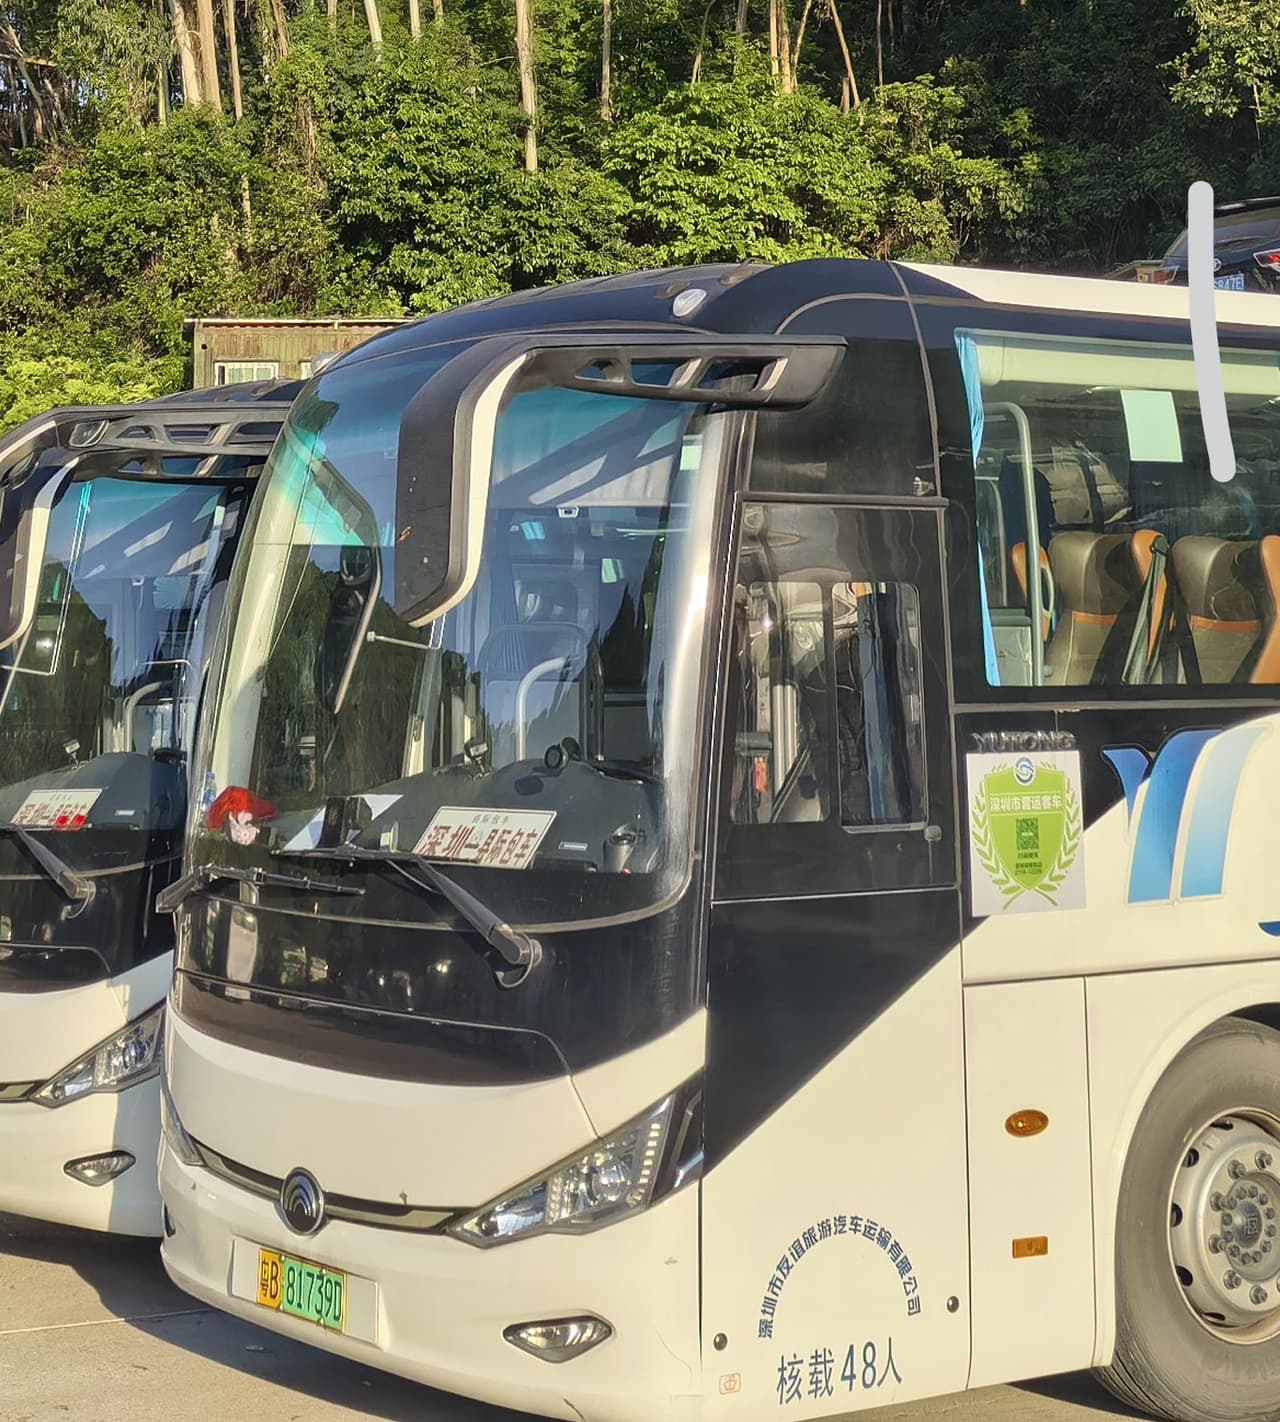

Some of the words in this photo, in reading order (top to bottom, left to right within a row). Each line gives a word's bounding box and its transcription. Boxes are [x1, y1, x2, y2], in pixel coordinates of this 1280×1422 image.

[971, 731, 1077, 752] YUTONG
[260, 1259, 343, 1322] 粤B81739D
[758, 1215, 921, 1339] 深圳市友谊旅游汽车运输有限公司
